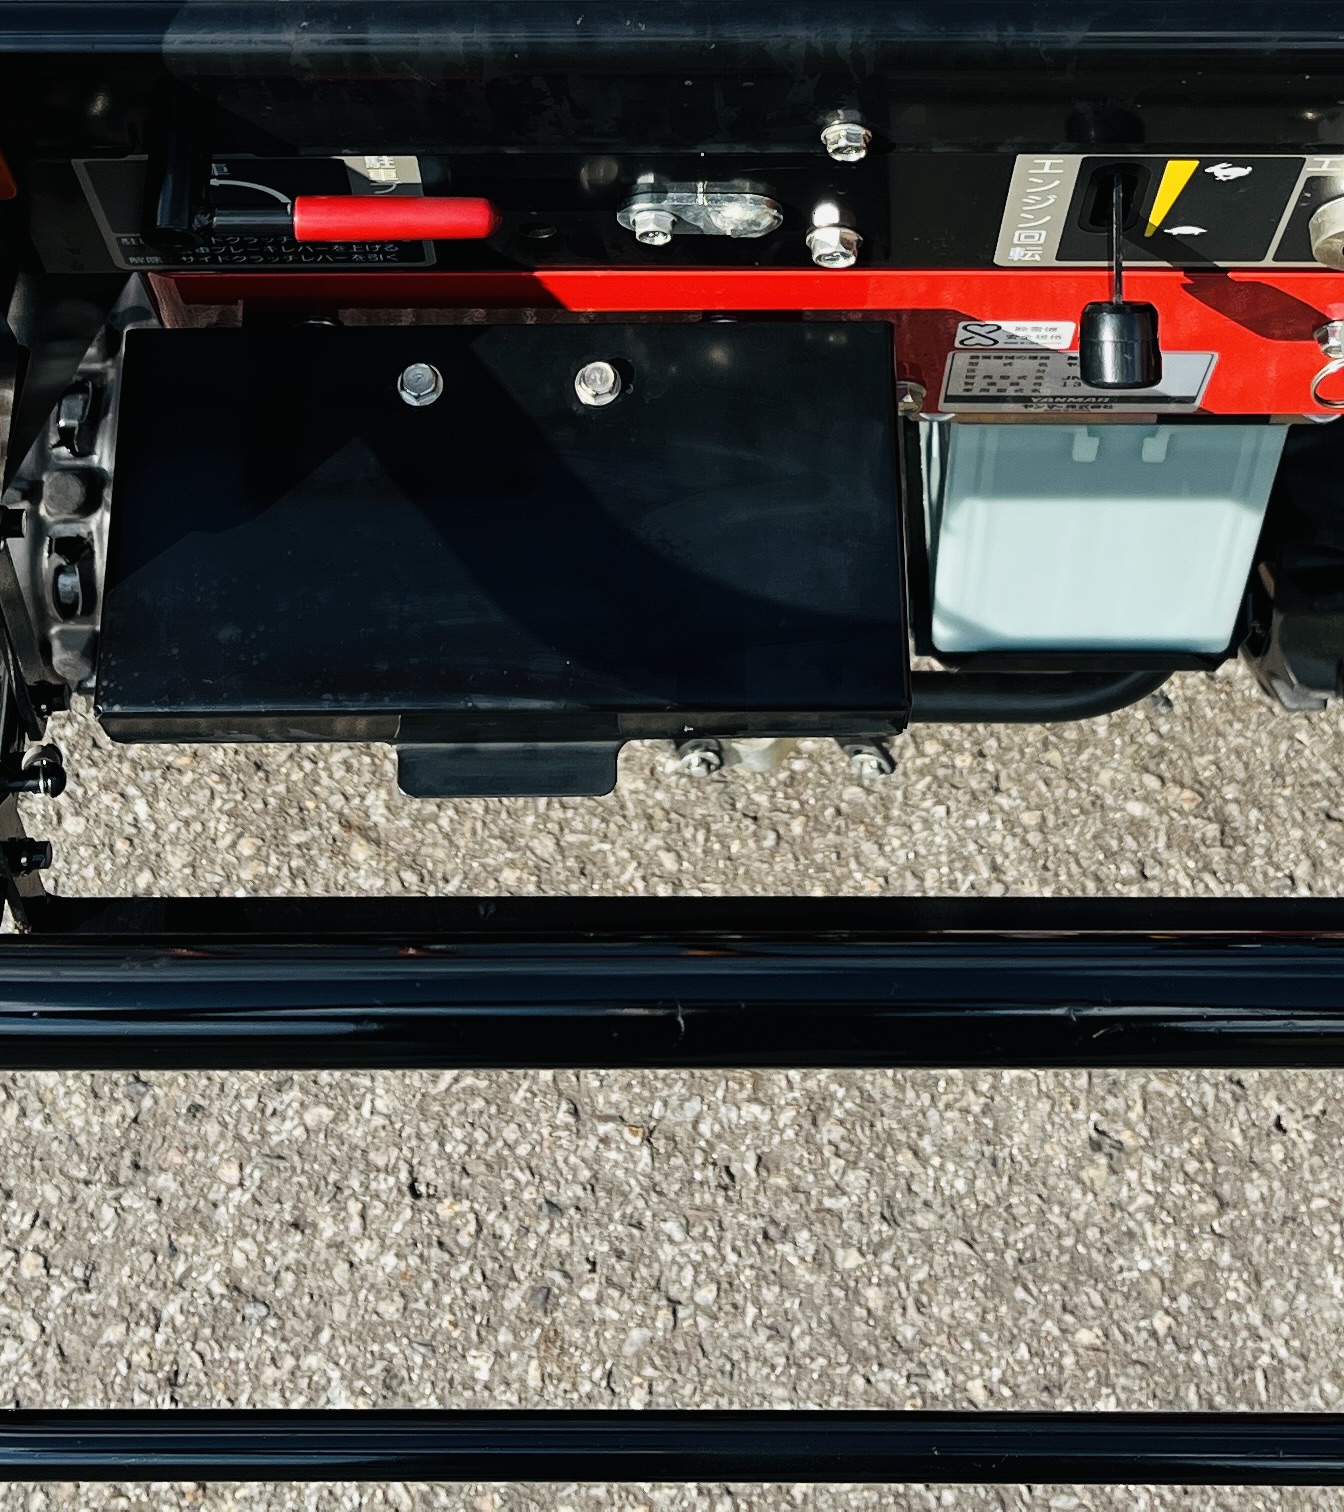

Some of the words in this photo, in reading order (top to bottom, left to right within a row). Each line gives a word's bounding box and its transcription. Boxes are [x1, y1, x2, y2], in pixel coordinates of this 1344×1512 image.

[1008, 159, 1064, 261] エンジン回転
